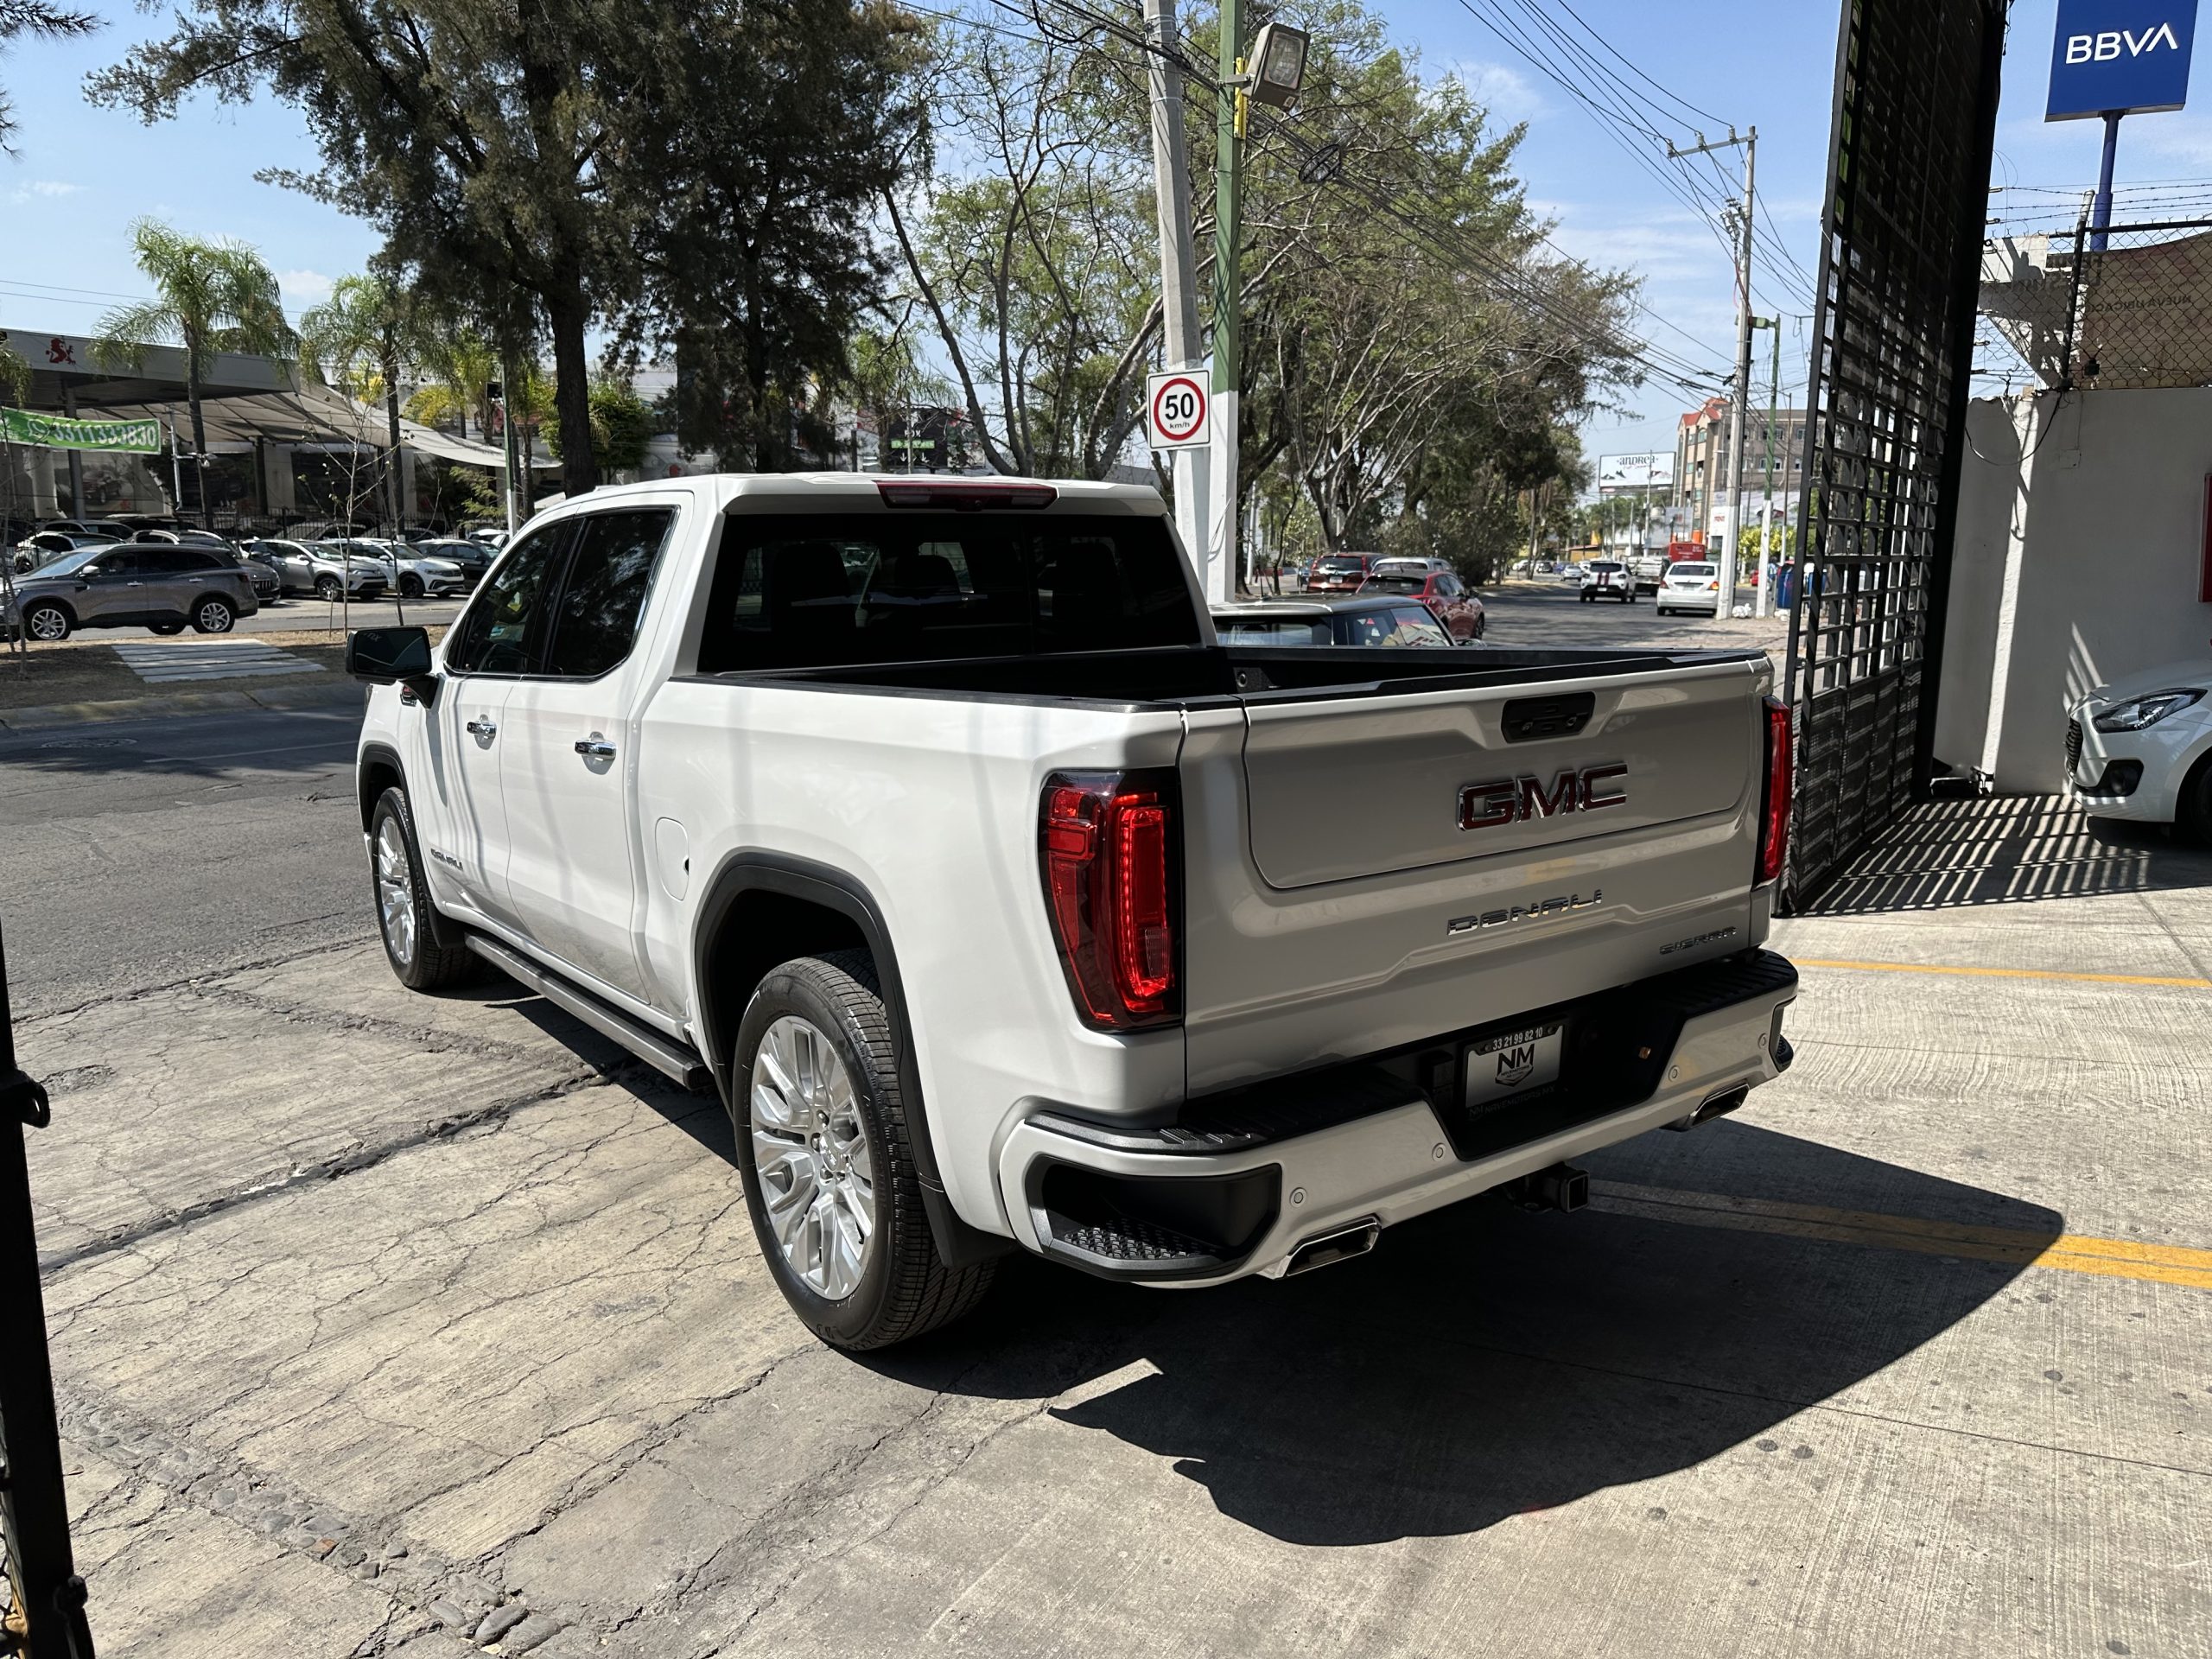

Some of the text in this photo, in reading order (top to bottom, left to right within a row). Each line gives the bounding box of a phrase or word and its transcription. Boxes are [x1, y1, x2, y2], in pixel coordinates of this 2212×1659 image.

[2065, 22, 2178, 64] BBVA
[1165, 392, 1194, 421] 50
[53, 422, 156, 447] 3311333830
[1169, 421, 1191, 429] km/h
[1457, 762, 1628, 831] GMC
[430, 848, 464, 871] DENALI
[1447, 889, 1603, 936] DENALI
[1659, 925, 1737, 955] SIERRA
[1492, 1027, 1543, 1051] 33 21 99 82 10
[1497, 1043, 1535, 1076] NM
